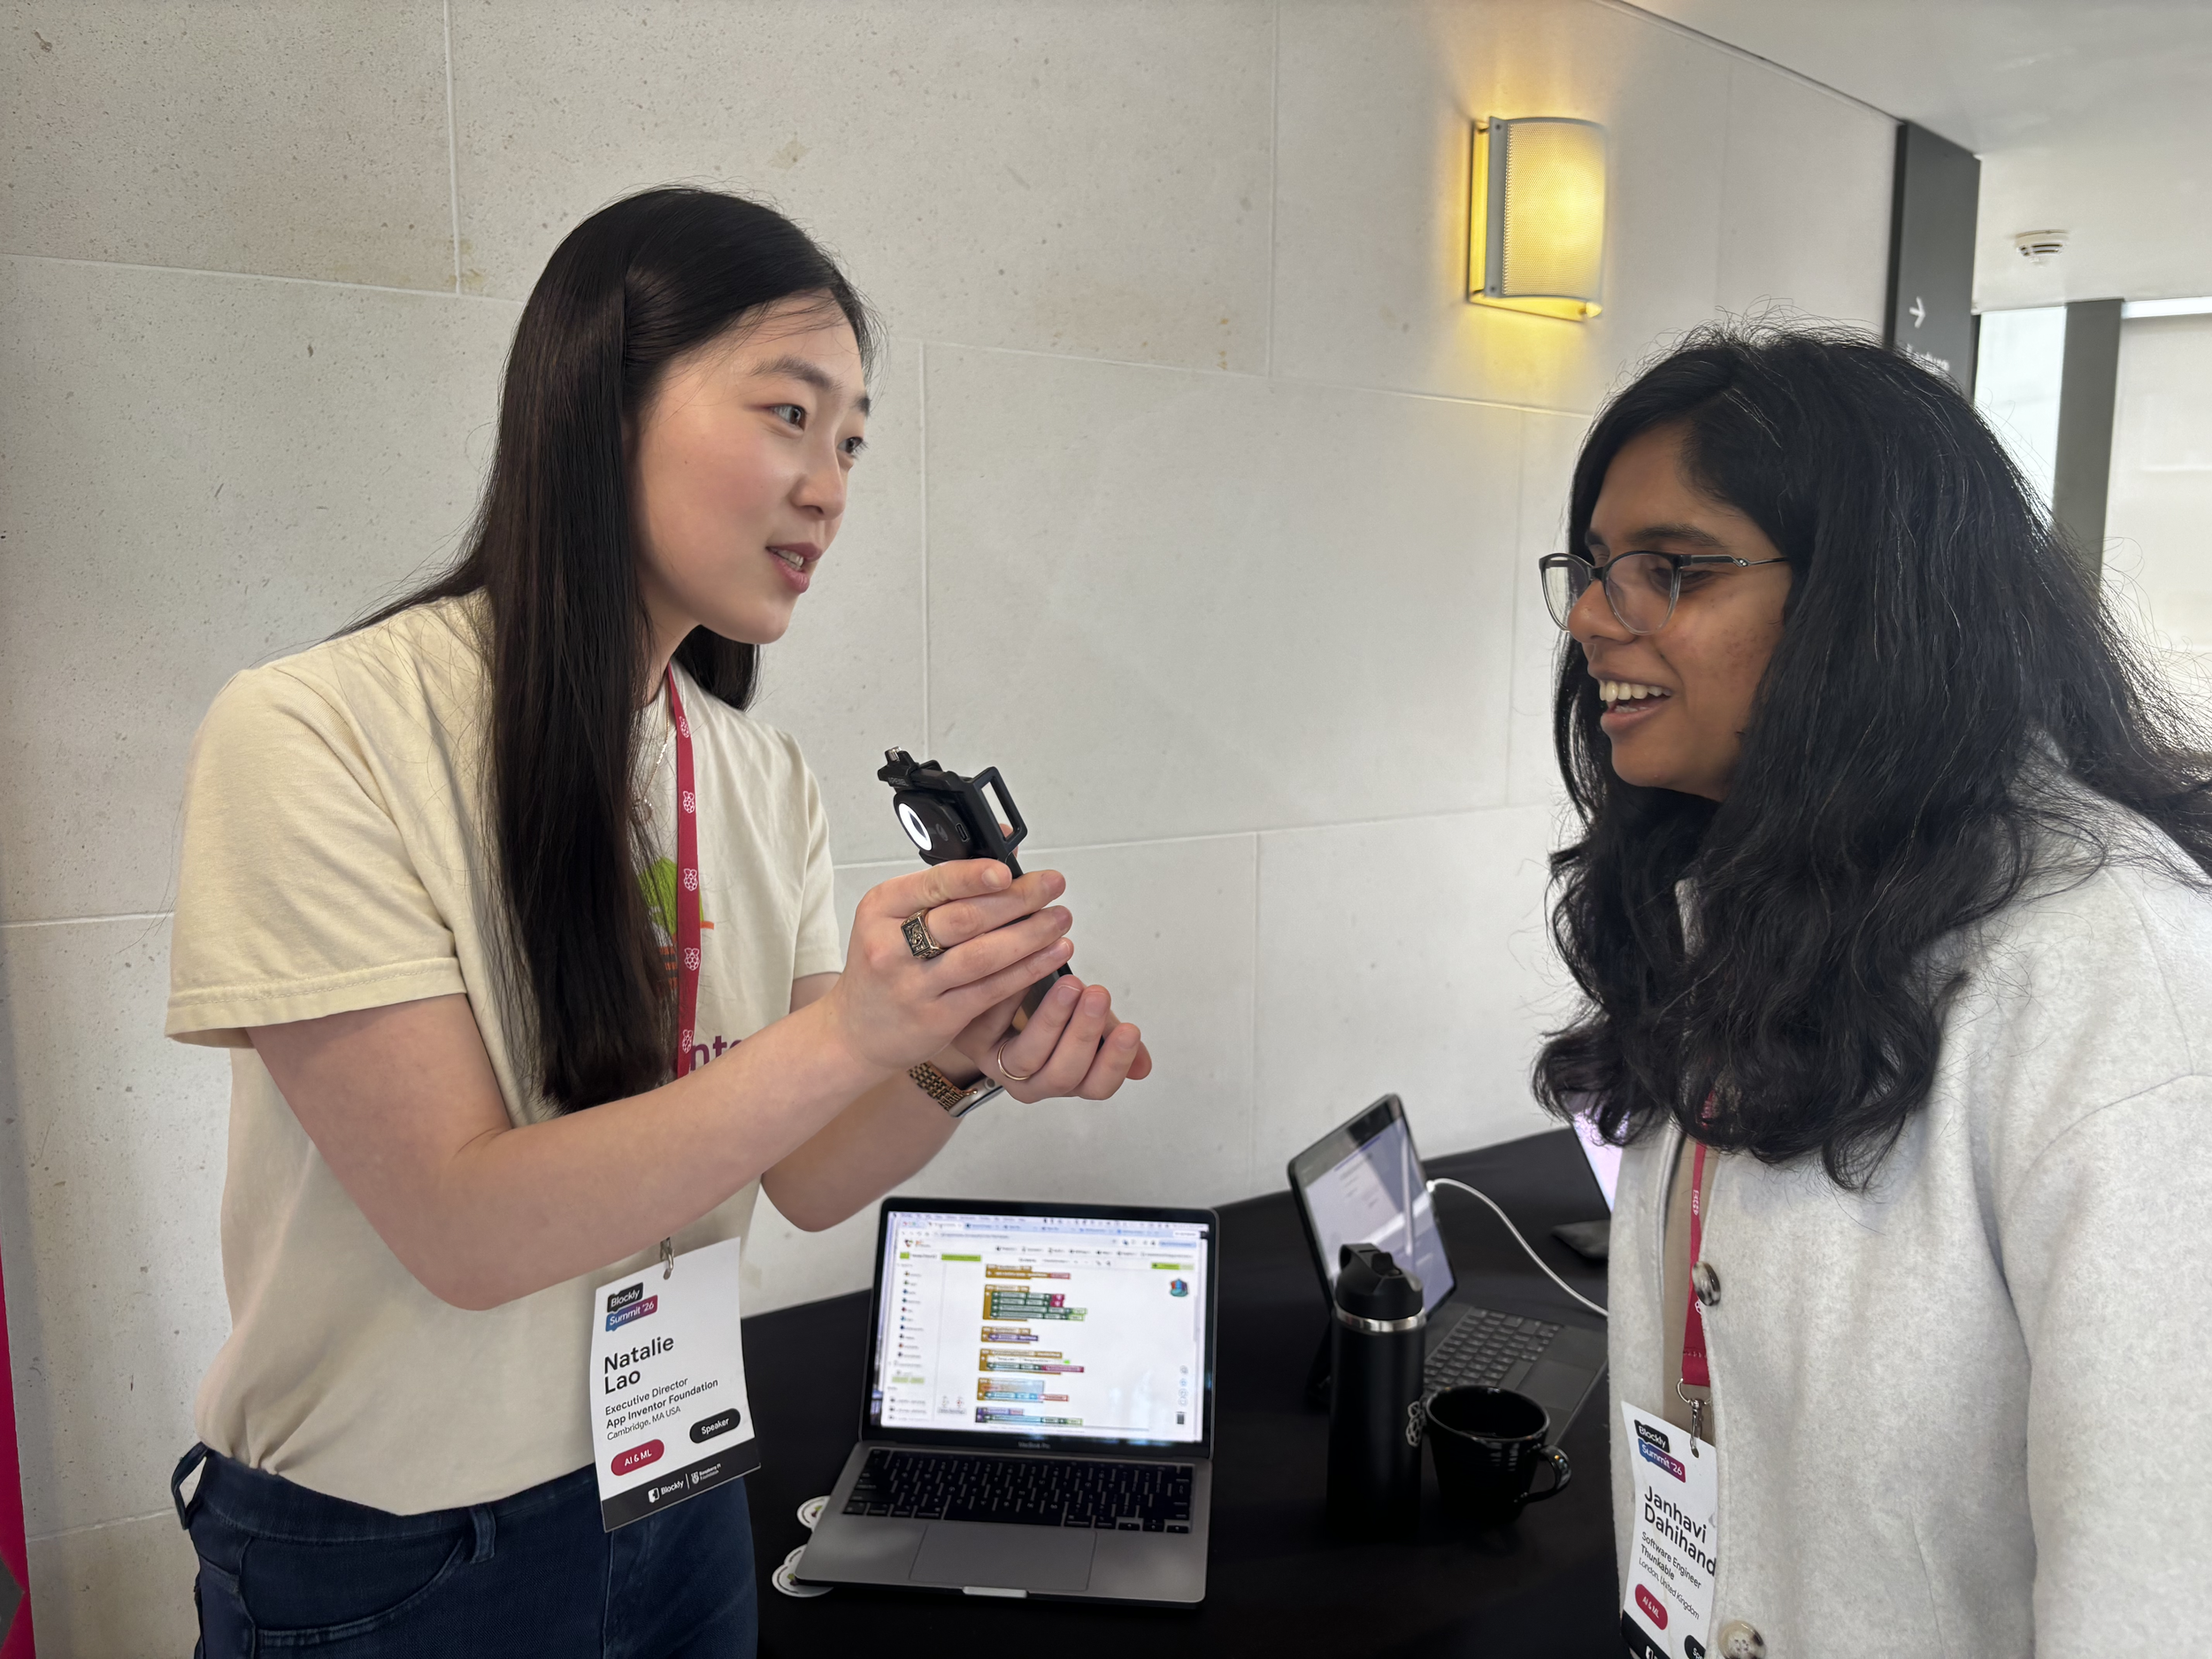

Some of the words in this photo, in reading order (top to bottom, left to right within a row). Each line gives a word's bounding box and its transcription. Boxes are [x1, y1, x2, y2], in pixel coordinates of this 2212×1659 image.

[690, 1035, 742, 1071] nt
[609, 1306, 641, 1325] Summit
[611, 1289, 641, 1307] Blockly
[604, 1336, 674, 1375] Natalie
[604, 1370, 641, 1394] Lao
[605, 1393, 650, 1416] Executive
[651, 1378, 688, 1398] Director
[606, 1416, 626, 1429] App
[628, 1399, 667, 1419] Inventor
[668, 1379, 718, 1404] Foundation
[607, 1419, 651, 1440] Cambridge,
[651, 1411, 665, 1424] MA
[665, 1405, 681, 1417] USA
[701, 1417, 730, 1435] Speaker
[1638, 1425, 1666, 1448] Blockly
[624, 1456, 633, 1466] AI
[634, 1454, 640, 1463] &
[640, 1448, 653, 1460] ML
[1641, 1444, 1671, 1469] Summit
[660, 1479, 684, 1495] Blockly
[1644, 1486, 1707, 1544] Janhavi
[1644, 1502, 1717, 1577] Dahihand
[1641, 1532, 1672, 1563] Software
[1672, 1556, 1701, 1589] Engineer
[1641, 1543, 1675, 1580] Thunkable
[1639, 1557, 1660, 1581] London,
[1660, 1576, 1677, 1597] United
[1677, 1592, 1700, 1620] Kingdom
